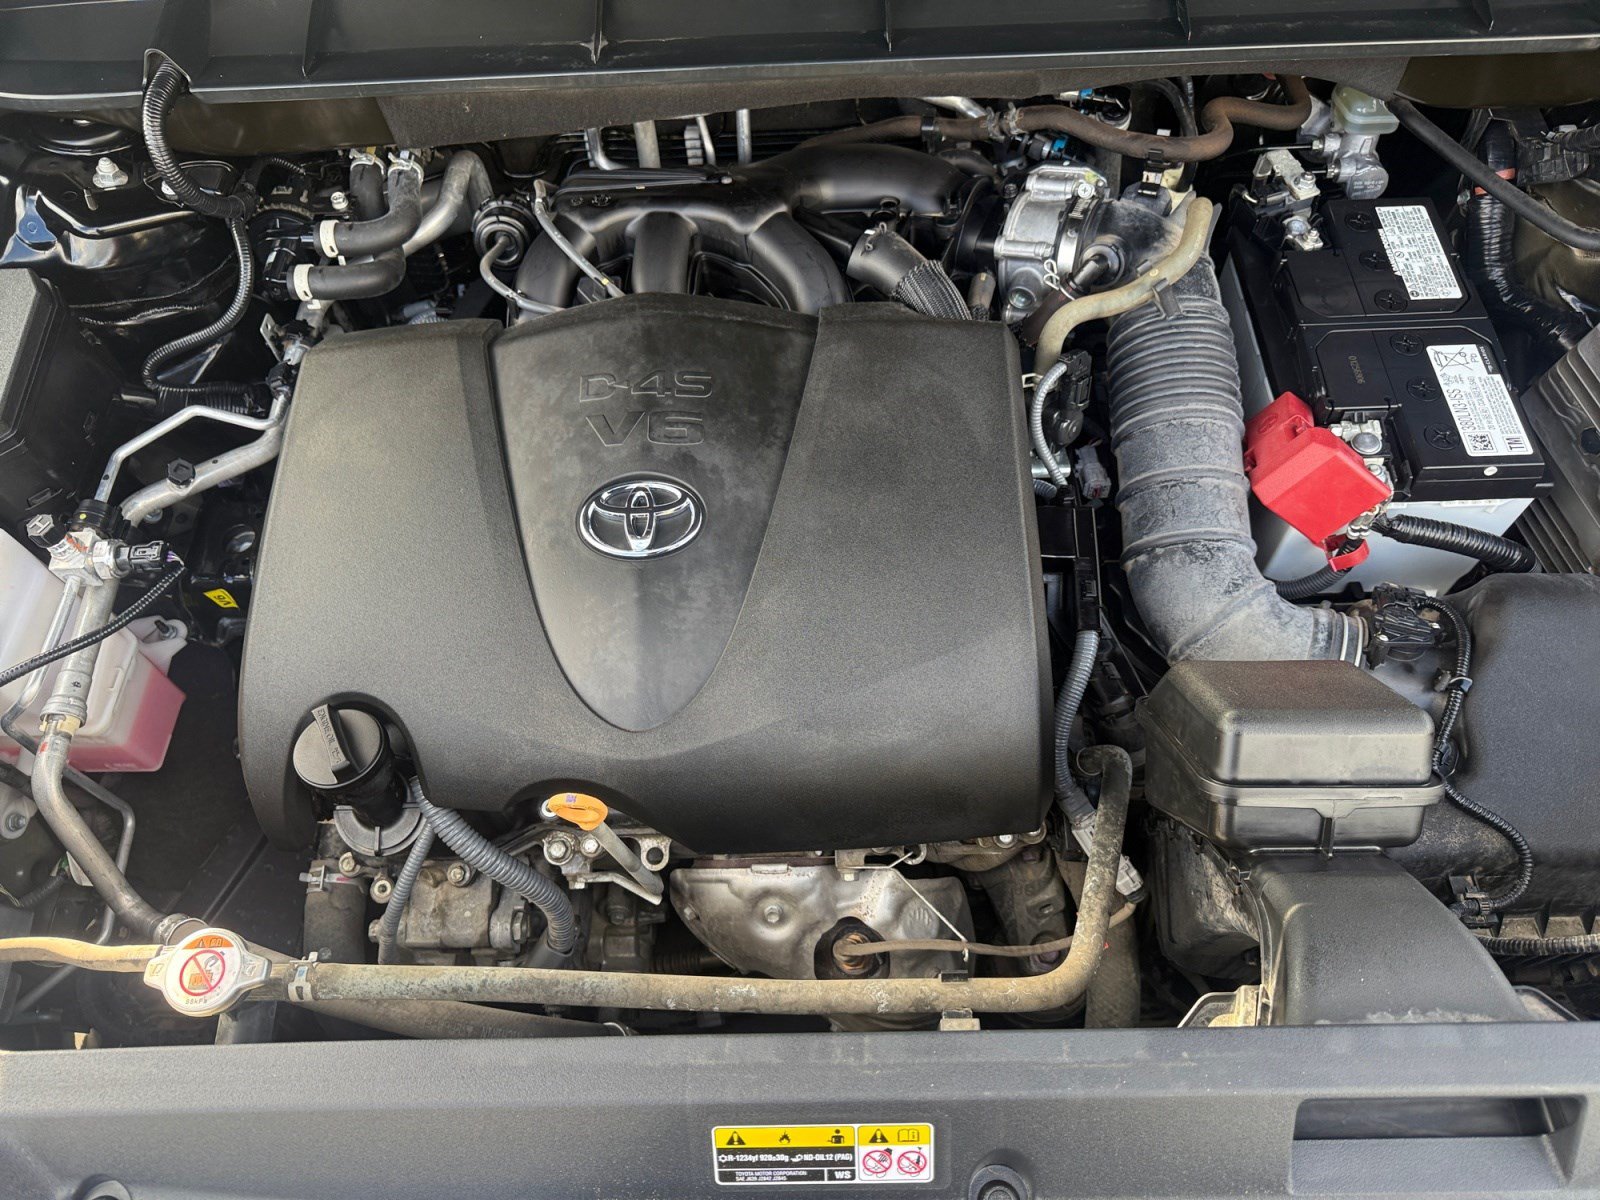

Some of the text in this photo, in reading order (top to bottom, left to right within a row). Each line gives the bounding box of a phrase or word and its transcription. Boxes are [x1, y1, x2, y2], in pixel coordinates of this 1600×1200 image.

[579, 370, 713, 402] D-4S
[585, 409, 706, 447] V6
[1505, 437, 1525, 451] TM
[834, 1170, 852, 1179] WS
